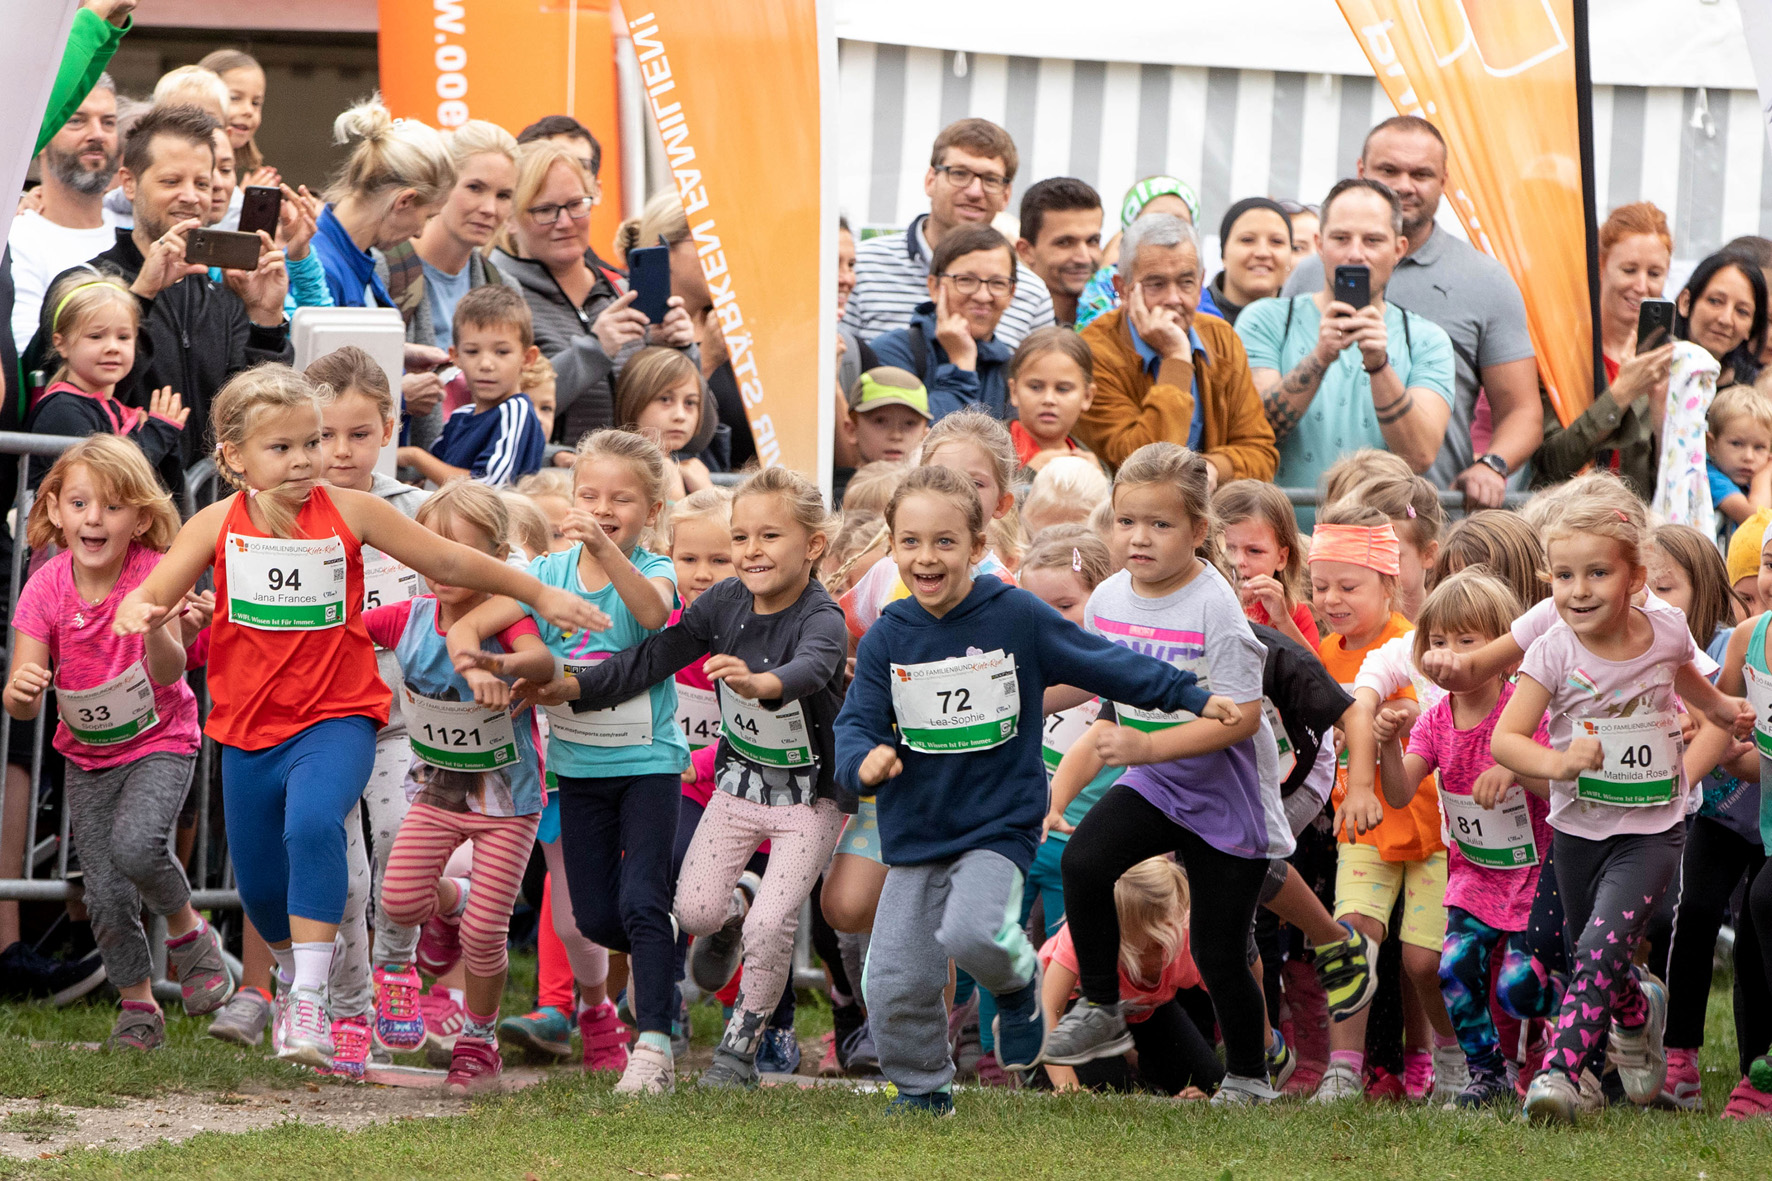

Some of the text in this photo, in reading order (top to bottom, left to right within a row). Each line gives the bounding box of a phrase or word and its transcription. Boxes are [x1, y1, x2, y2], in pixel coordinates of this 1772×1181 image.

[262, 544, 308, 553] FAMILIENBUND
[268, 567, 302, 591] 94
[253, 592, 275, 603] Jana
[278, 593, 317, 603] Frances
[361, 589, 382, 612] 5
[281, 617, 292, 625] Für
[926, 663, 973, 676] FAMILIENBUND
[937, 688, 972, 714] 72
[78, 705, 111, 723] 33
[929, 712, 985, 727] Lea-Sophie
[81, 722, 114, 731] Sophia
[681, 716, 721, 738] 143
[733, 713, 760, 736] 44
[1043, 713, 1065, 733] 7
[1613, 720, 1658, 731] FAMILIENBUND
[423, 723, 482, 746] 1121
[740, 731, 757, 744] Lara
[958, 738, 969, 748] Für
[970, 737, 993, 746] Immer.
[1620, 744, 1652, 768] 40
[1603, 769, 1669, 780] Mathilda Rose
[1457, 816, 1483, 837] 81
[1465, 836, 1484, 846] Julia
